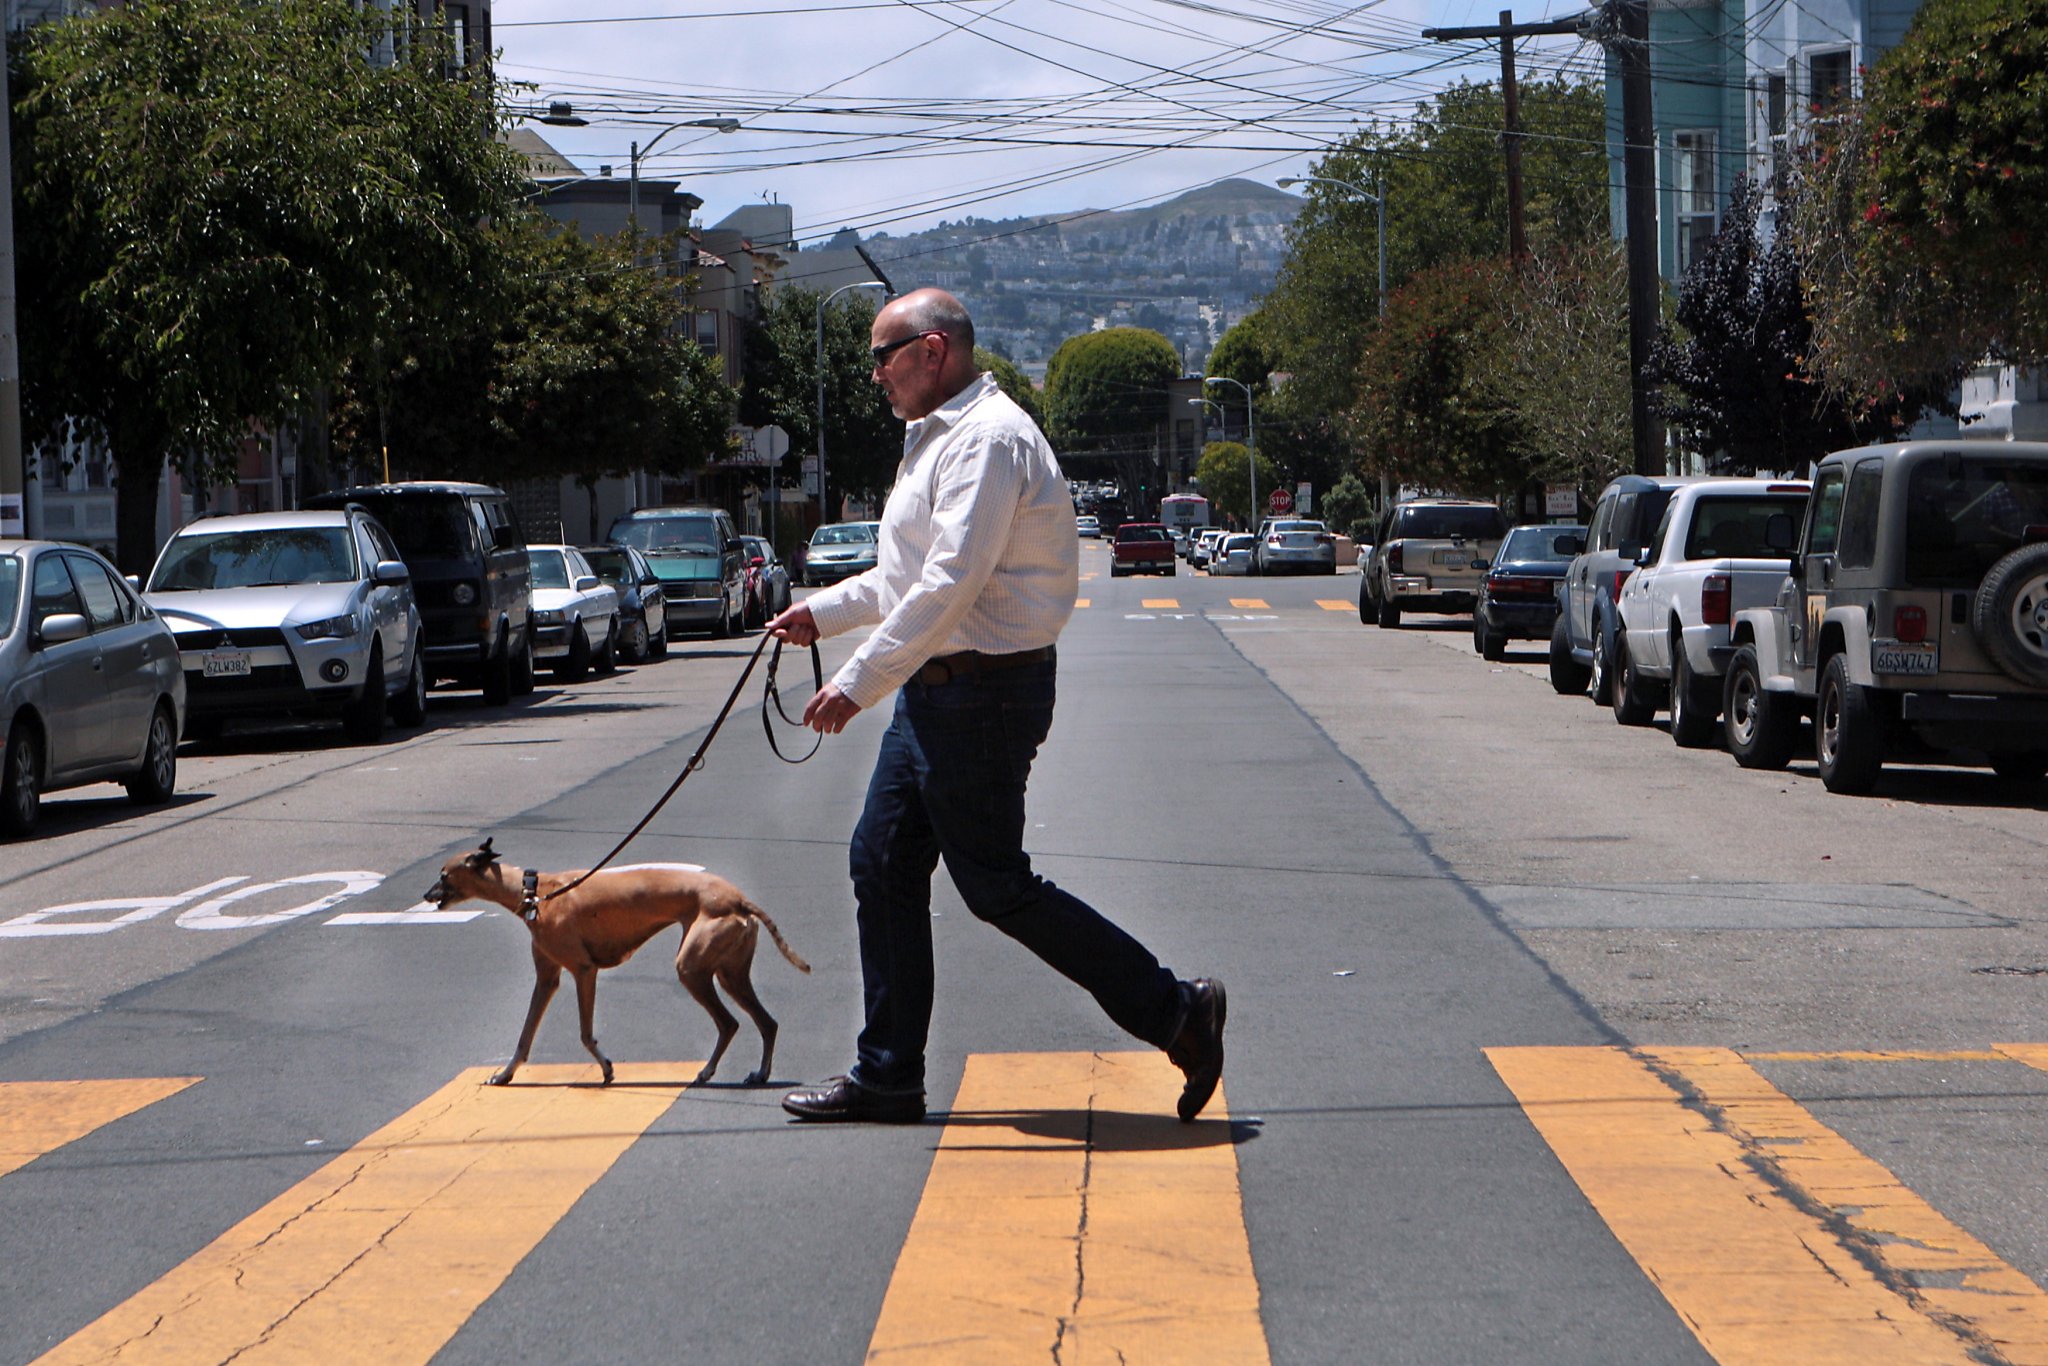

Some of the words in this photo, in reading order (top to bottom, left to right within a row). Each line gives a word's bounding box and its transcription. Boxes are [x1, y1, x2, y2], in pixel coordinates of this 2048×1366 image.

[1271, 496, 1290, 506] STOP
[207, 659, 247, 673] 6ZLW382
[1877, 652, 1933, 670] 6GSW747
